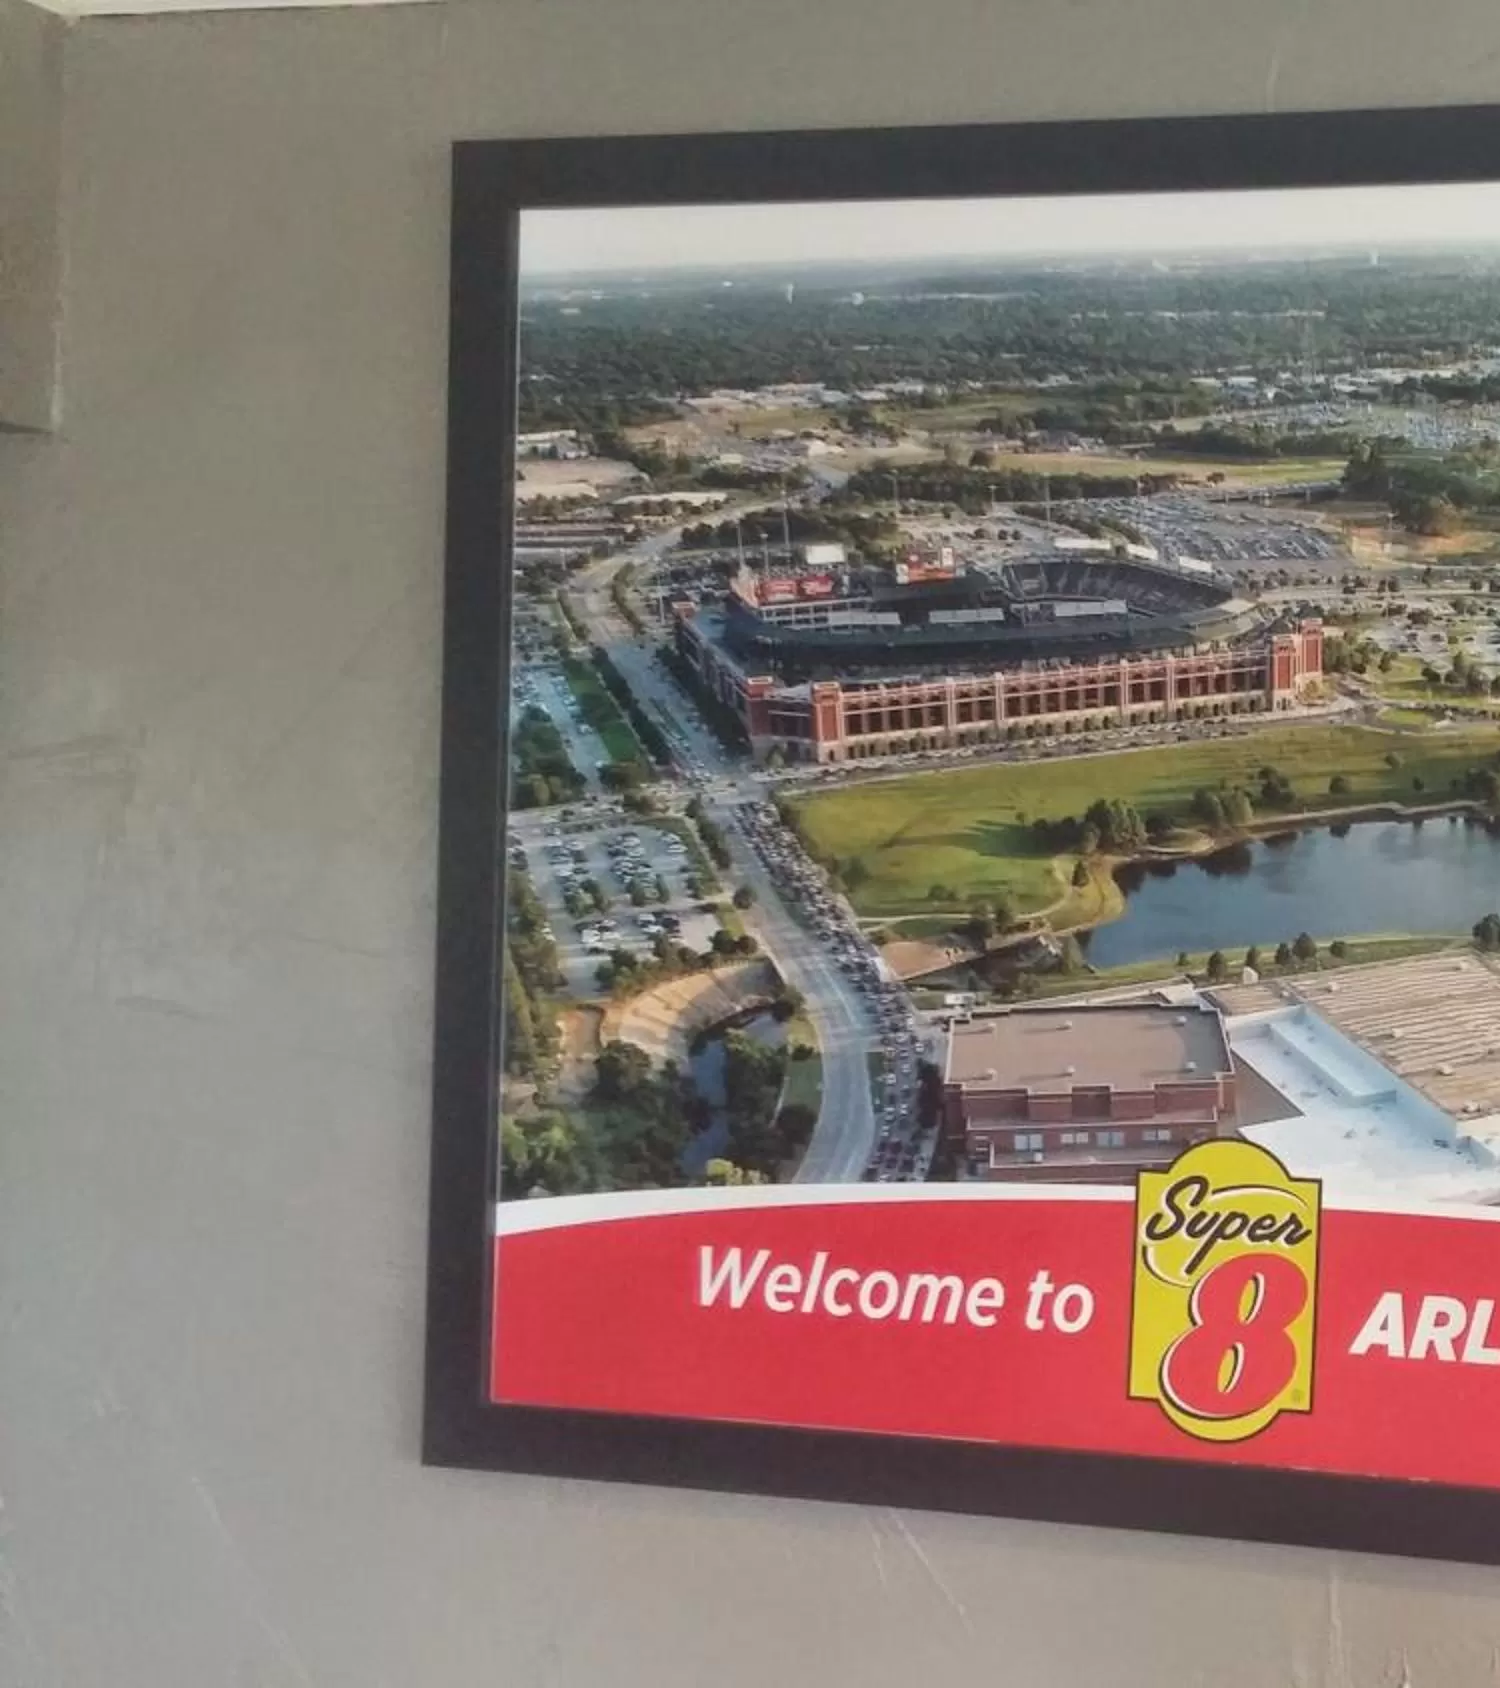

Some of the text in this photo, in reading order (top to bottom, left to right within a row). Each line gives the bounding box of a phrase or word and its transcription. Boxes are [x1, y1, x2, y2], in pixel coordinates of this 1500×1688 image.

[1144, 1175, 1312, 1276] Super
[699, 1246, 1095, 1334] Welcome to
[1158, 1252, 1309, 1422] 8
